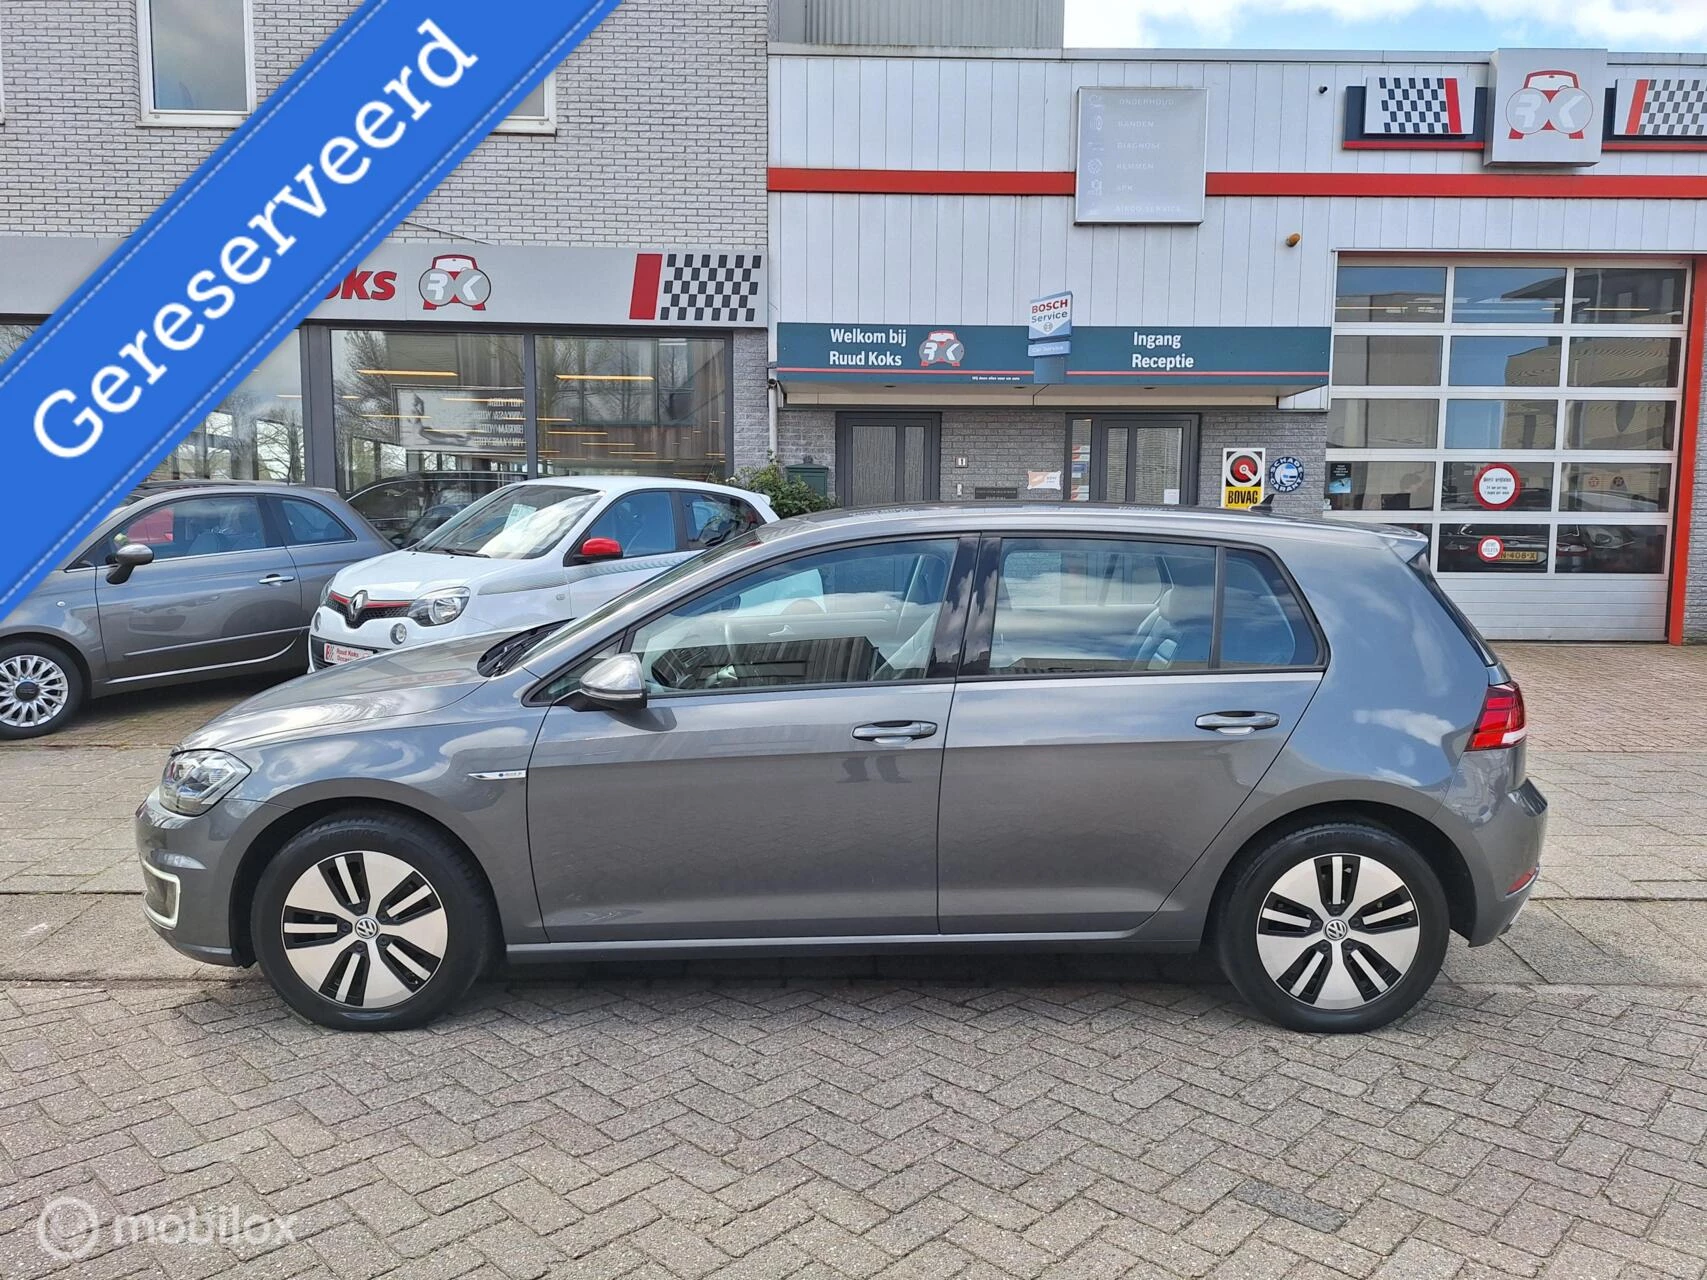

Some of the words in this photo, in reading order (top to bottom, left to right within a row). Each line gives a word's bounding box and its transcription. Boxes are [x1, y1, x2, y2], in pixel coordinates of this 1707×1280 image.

[1031, 299, 1068, 314] BOSCH
[1031, 311, 1068, 323] Service
[830, 328, 886, 344] Welkom
[889, 330, 907, 347] bij
[1133, 331, 1181, 349] Ingang
[829, 351, 865, 365] Ruud
[868, 352, 902, 365] Koks
[1132, 353, 1194, 371] Receptie
[1228, 490, 1258, 504] BOVAG
